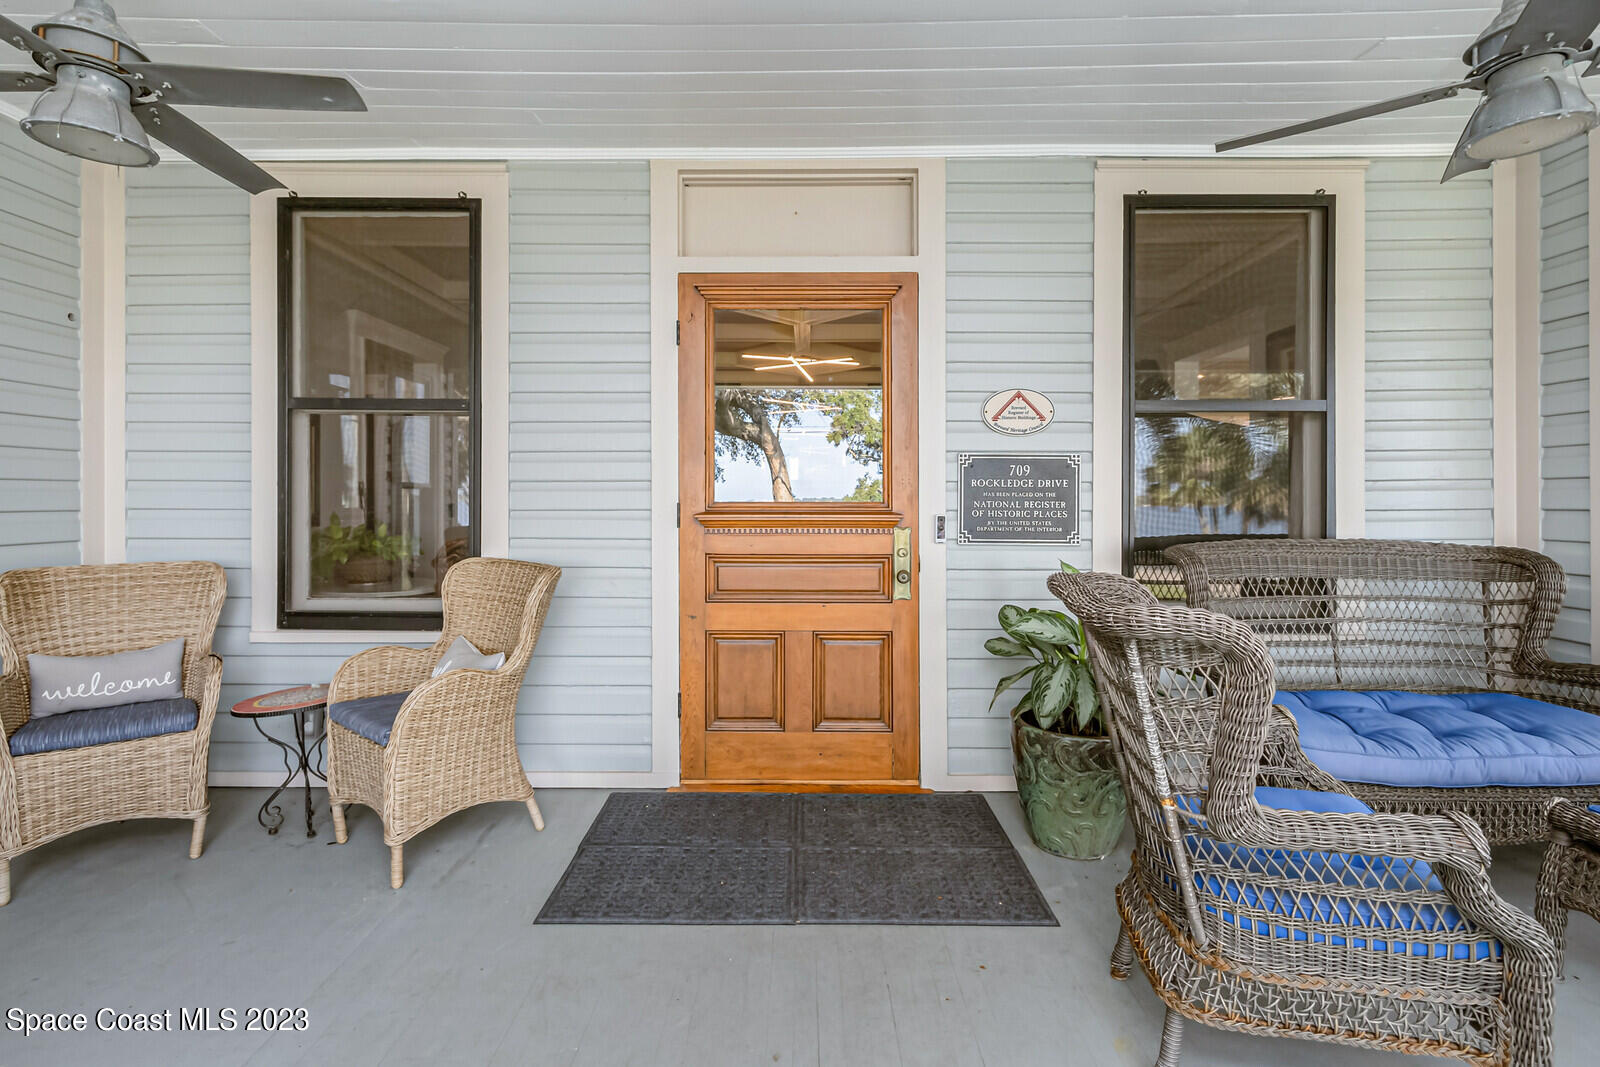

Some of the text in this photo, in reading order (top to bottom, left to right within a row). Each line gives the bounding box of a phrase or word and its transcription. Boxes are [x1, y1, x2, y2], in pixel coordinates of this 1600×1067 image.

[1009, 464, 1031, 477] 709
[971, 479, 1069, 488] ROCKLEDGE DRIVE
[973, 500, 1066, 509] NATIONAL REGISTER
[971, 510, 1068, 518] OF HISTORIC PLACES
[42, 671, 177, 700] welcome
